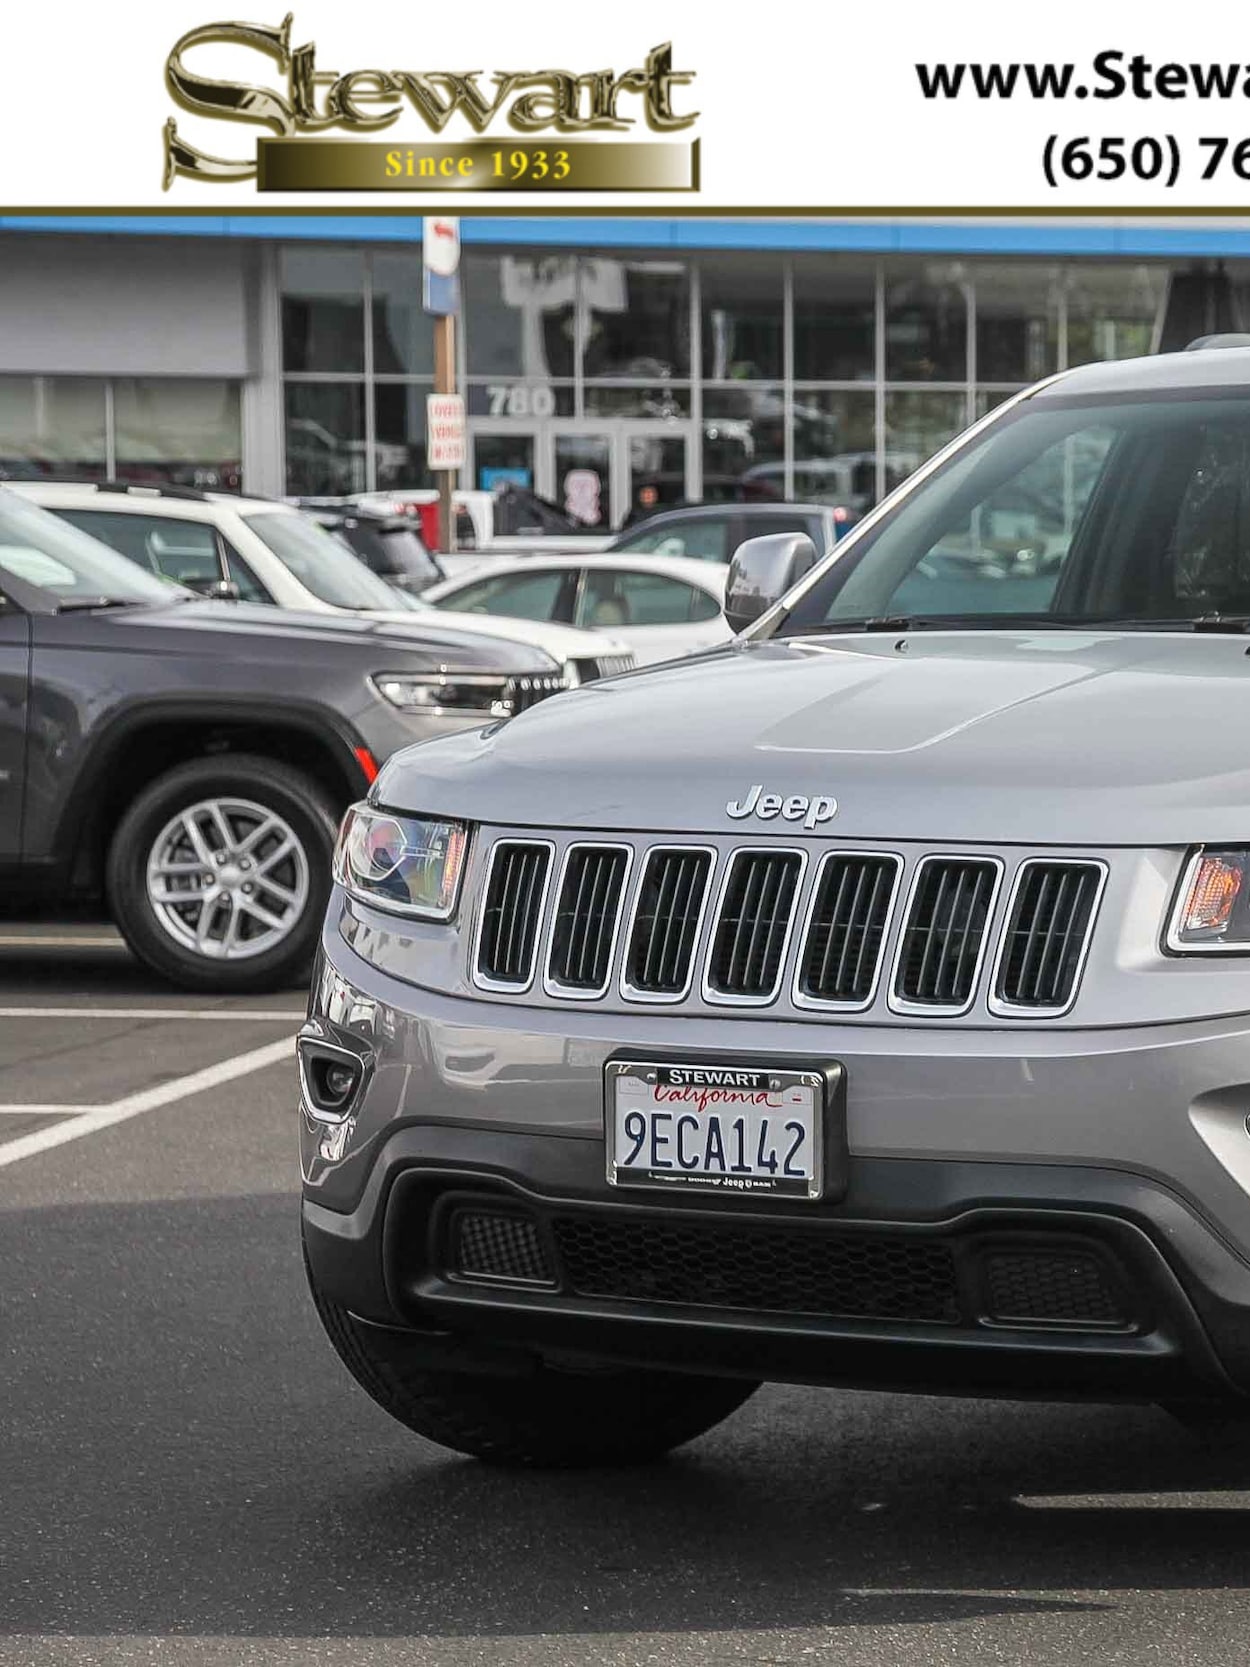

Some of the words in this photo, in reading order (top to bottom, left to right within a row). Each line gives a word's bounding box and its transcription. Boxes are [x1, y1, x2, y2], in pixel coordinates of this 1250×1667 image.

[486, 386, 556, 416] 780
[726, 784, 838, 830] Jeep
[669, 1069, 760, 1087] STEWART
[654, 1084, 782, 1112] California
[624, 1111, 806, 1177] 9ECA142
[723, 1177, 744, 1189] Jeep
